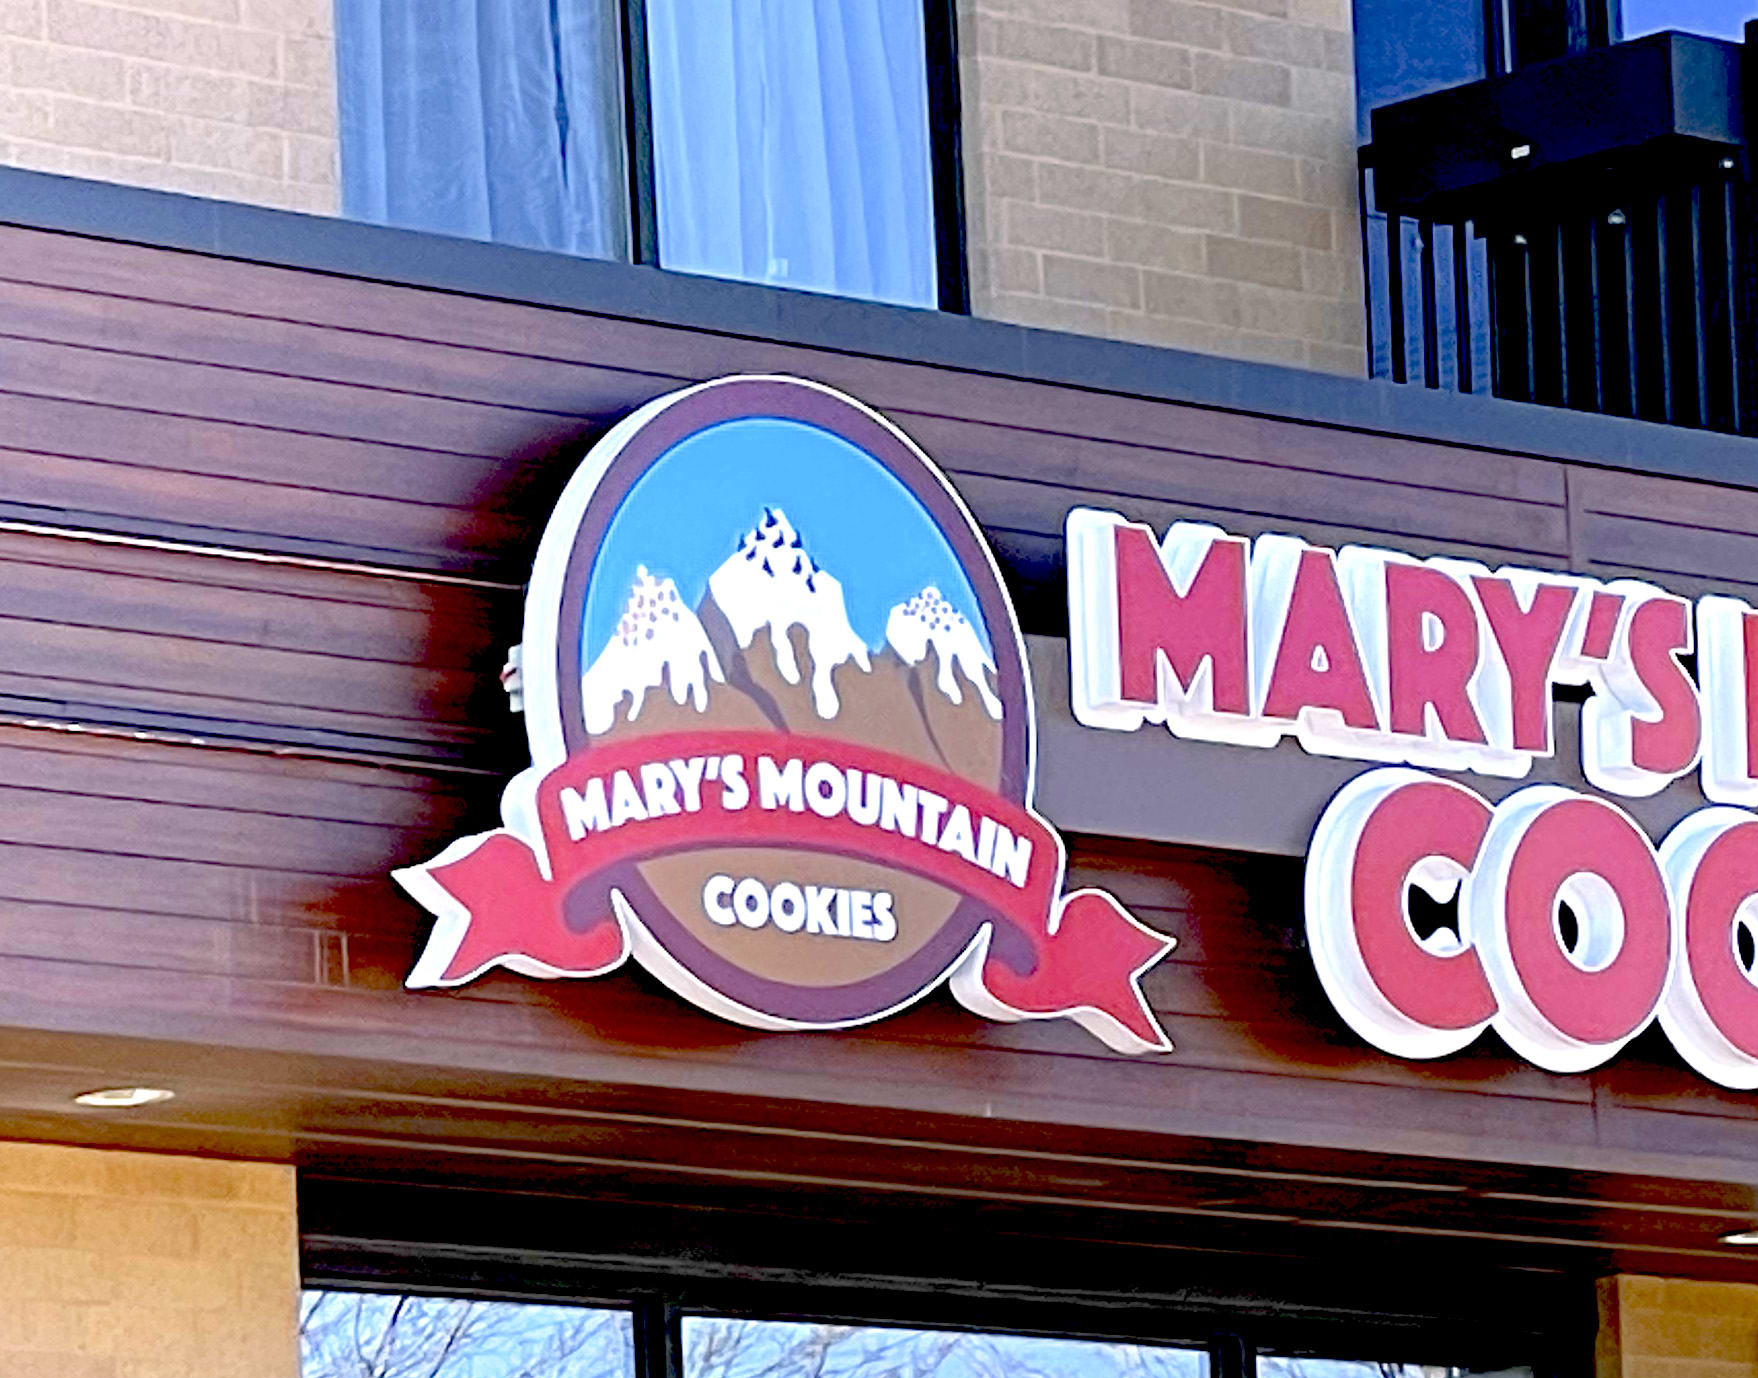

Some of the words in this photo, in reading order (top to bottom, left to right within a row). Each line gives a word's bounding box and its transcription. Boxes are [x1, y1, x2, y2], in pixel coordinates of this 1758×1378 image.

[1112, 523, 1703, 775] MARY'S
[559, 754, 750, 842] MARY'S
[757, 756, 1033, 888] MOUNTAIN
[702, 874, 898, 942] COOKIES
